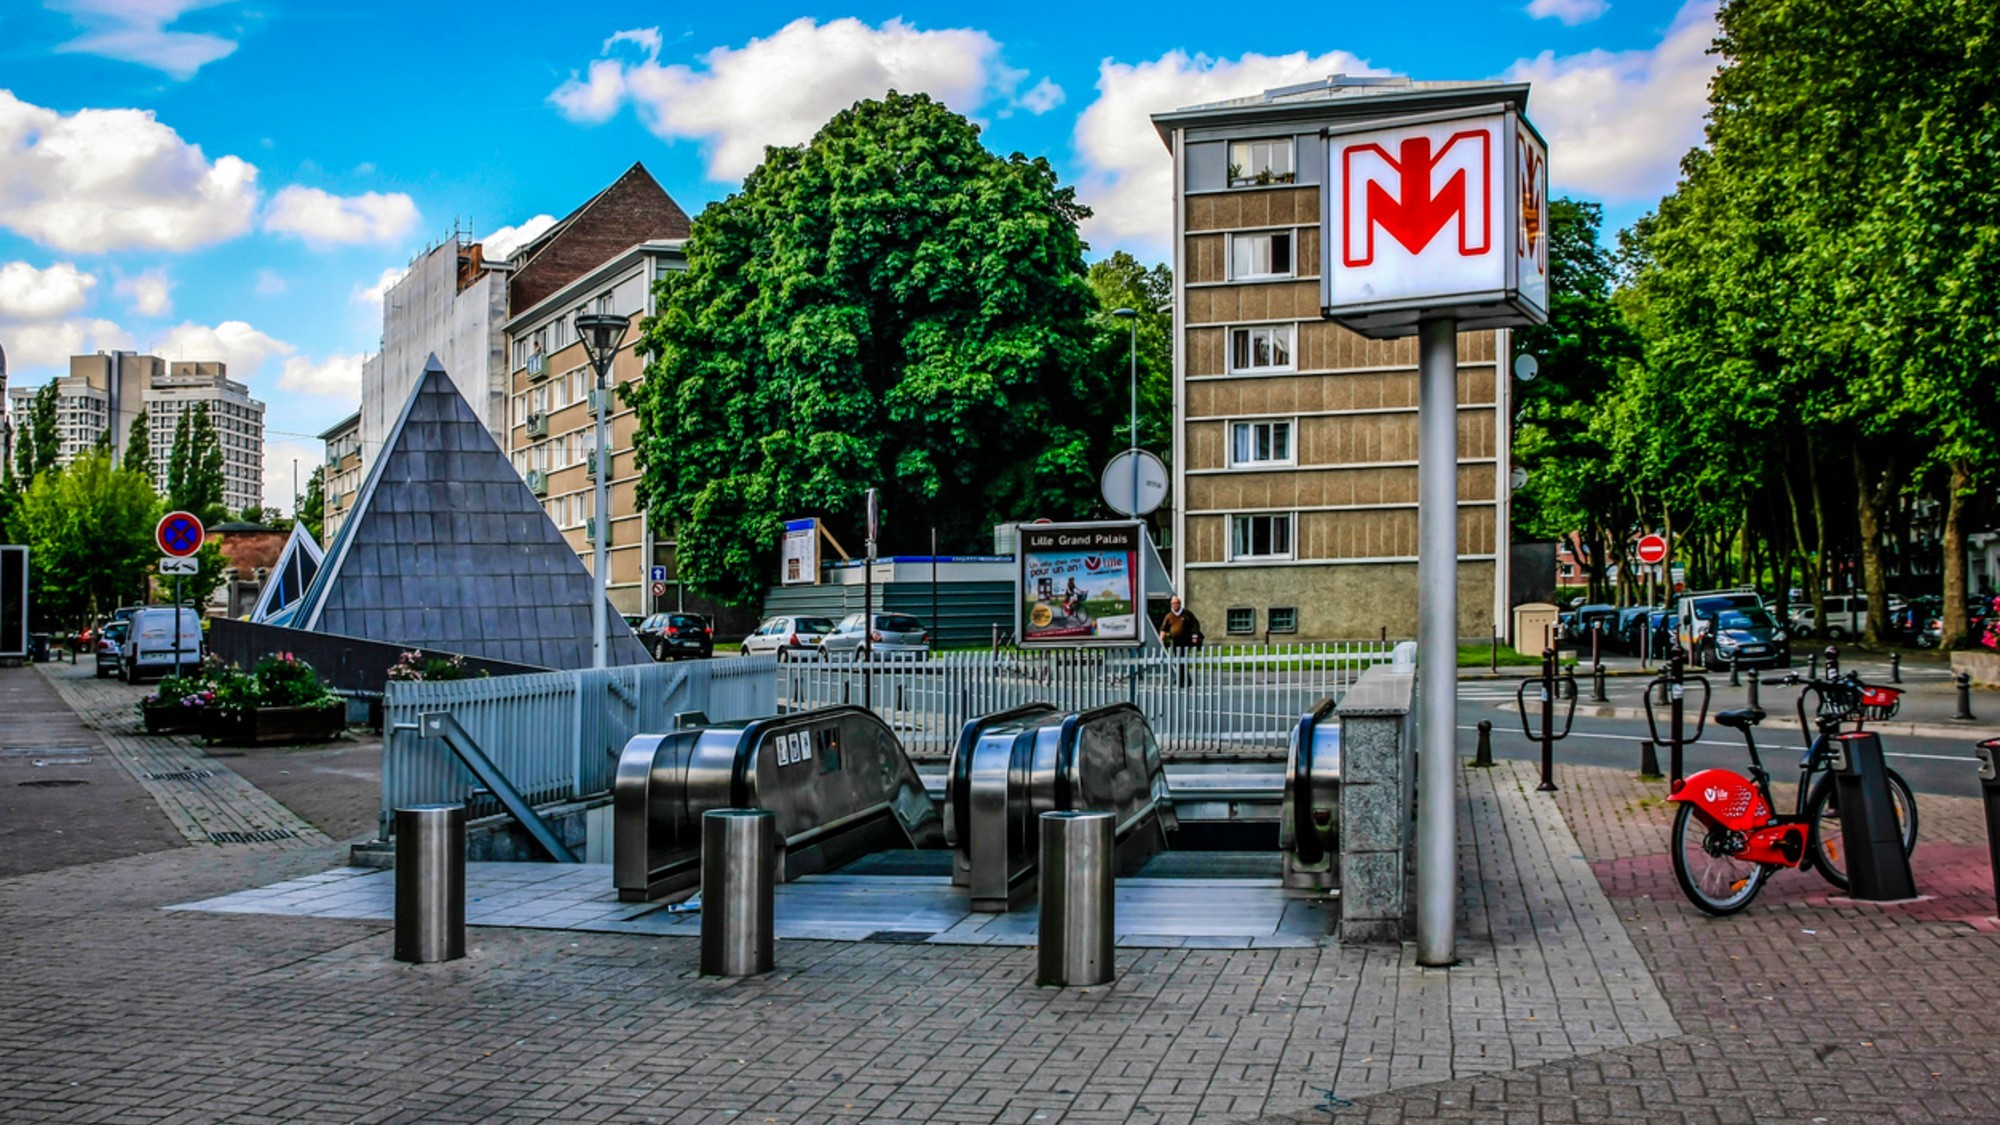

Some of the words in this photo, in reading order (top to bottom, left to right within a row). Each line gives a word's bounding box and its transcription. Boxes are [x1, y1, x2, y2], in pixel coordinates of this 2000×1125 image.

[1343, 129, 1490, 267] M
[1030, 535, 1054, 546] Lille
[1058, 534, 1091, 546] Grand
[1095, 533, 1128, 544] Palais
[1030, 567, 1049, 578] pour
[1052, 566, 1064, 574] un
